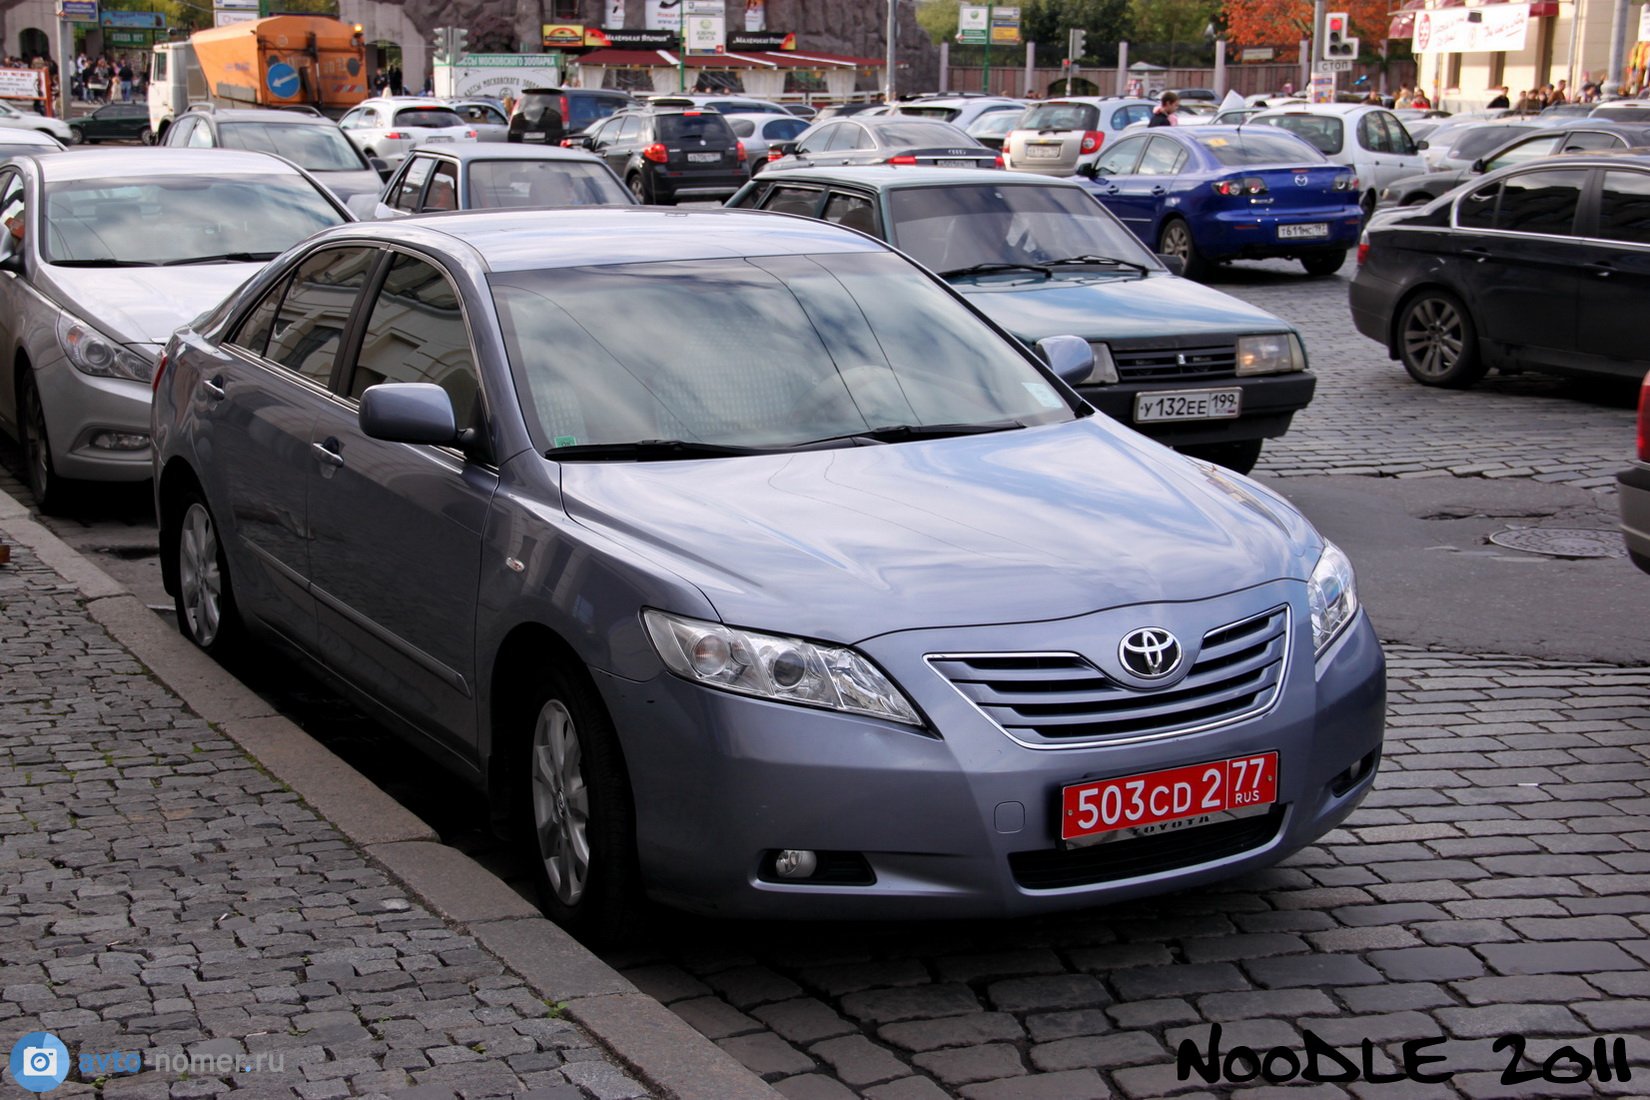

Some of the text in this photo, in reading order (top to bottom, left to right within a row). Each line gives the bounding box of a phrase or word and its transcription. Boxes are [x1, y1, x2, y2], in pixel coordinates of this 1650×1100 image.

[1321, 61, 1349, 71] СТОП
[1232, 757, 1265, 792] 77
[1234, 790, 1260, 805] RUS
